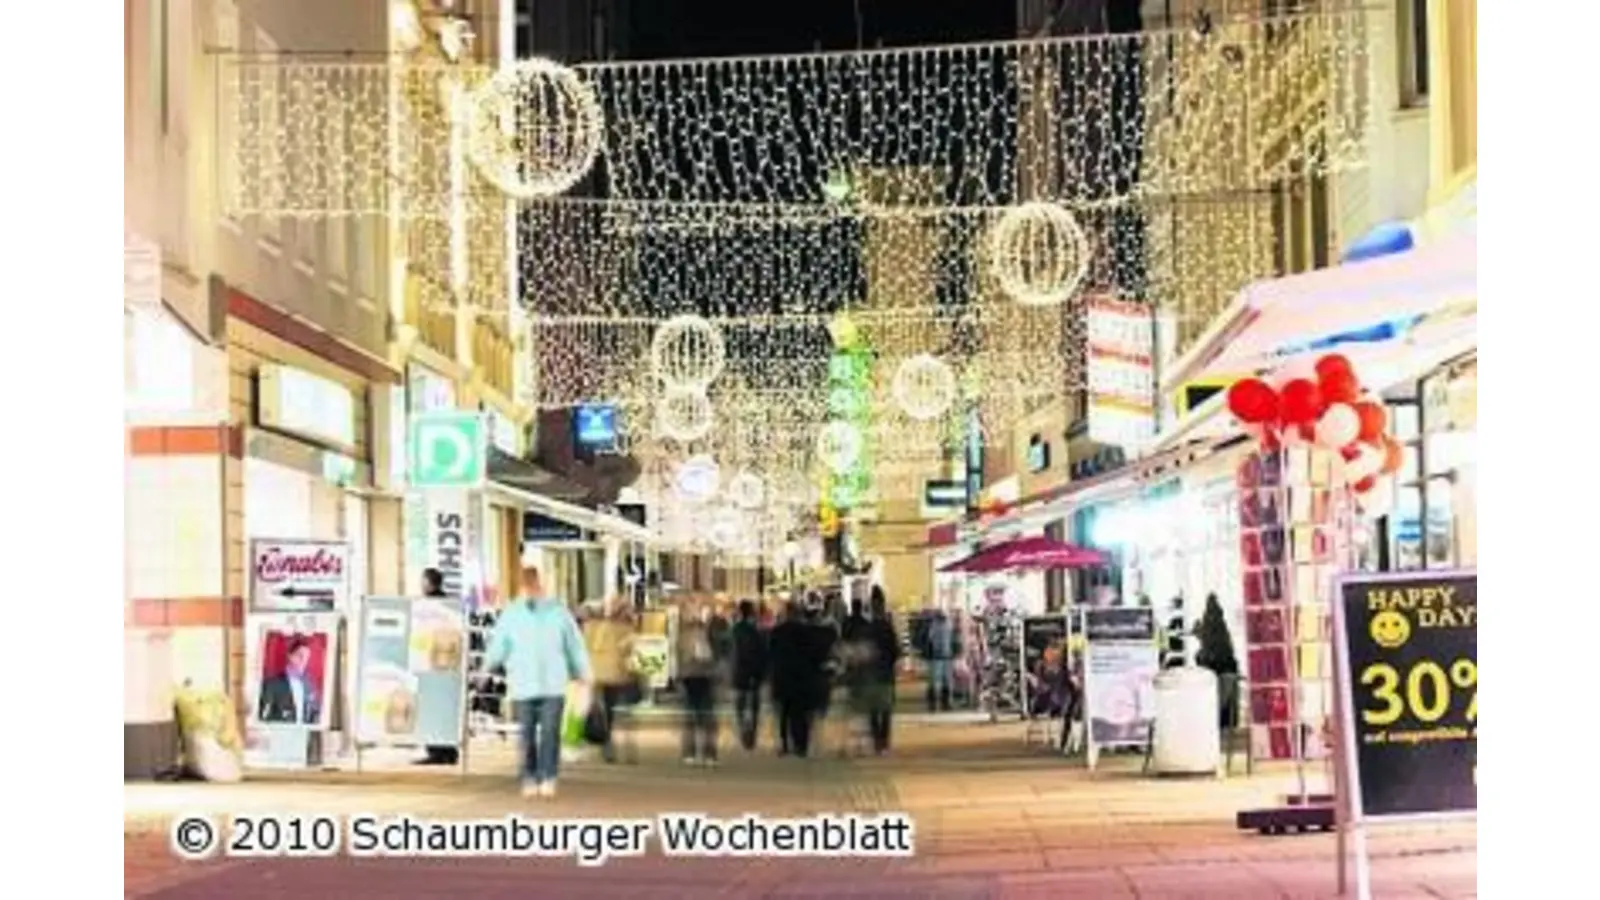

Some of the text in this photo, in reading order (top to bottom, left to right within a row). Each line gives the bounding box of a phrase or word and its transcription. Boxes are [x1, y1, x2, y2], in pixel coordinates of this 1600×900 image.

[436, 512, 462, 600] SCHU
[1367, 584, 1455, 610] HAPPY
[1418, 606, 1477, 628] DAY
